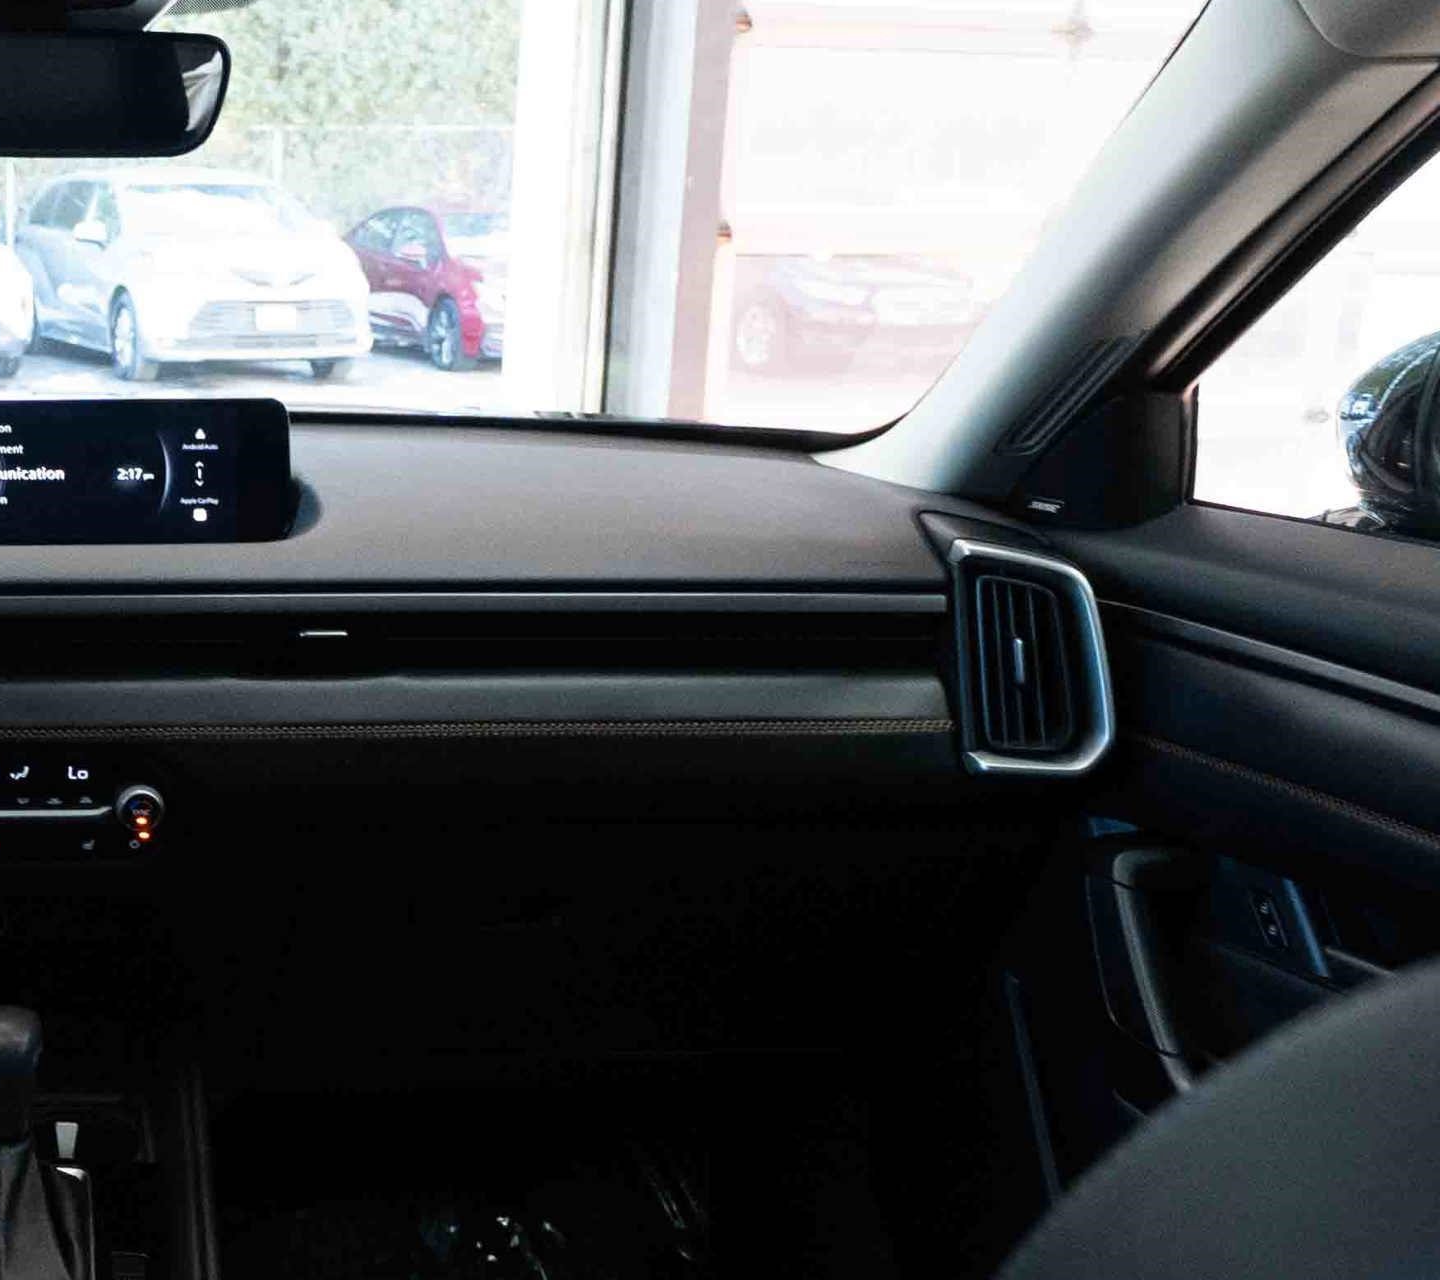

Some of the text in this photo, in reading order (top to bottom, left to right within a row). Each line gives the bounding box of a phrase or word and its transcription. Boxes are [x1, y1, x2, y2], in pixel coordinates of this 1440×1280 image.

[182, 443, 218, 451] Android Auto
[68, 766, 89, 780] Lo
